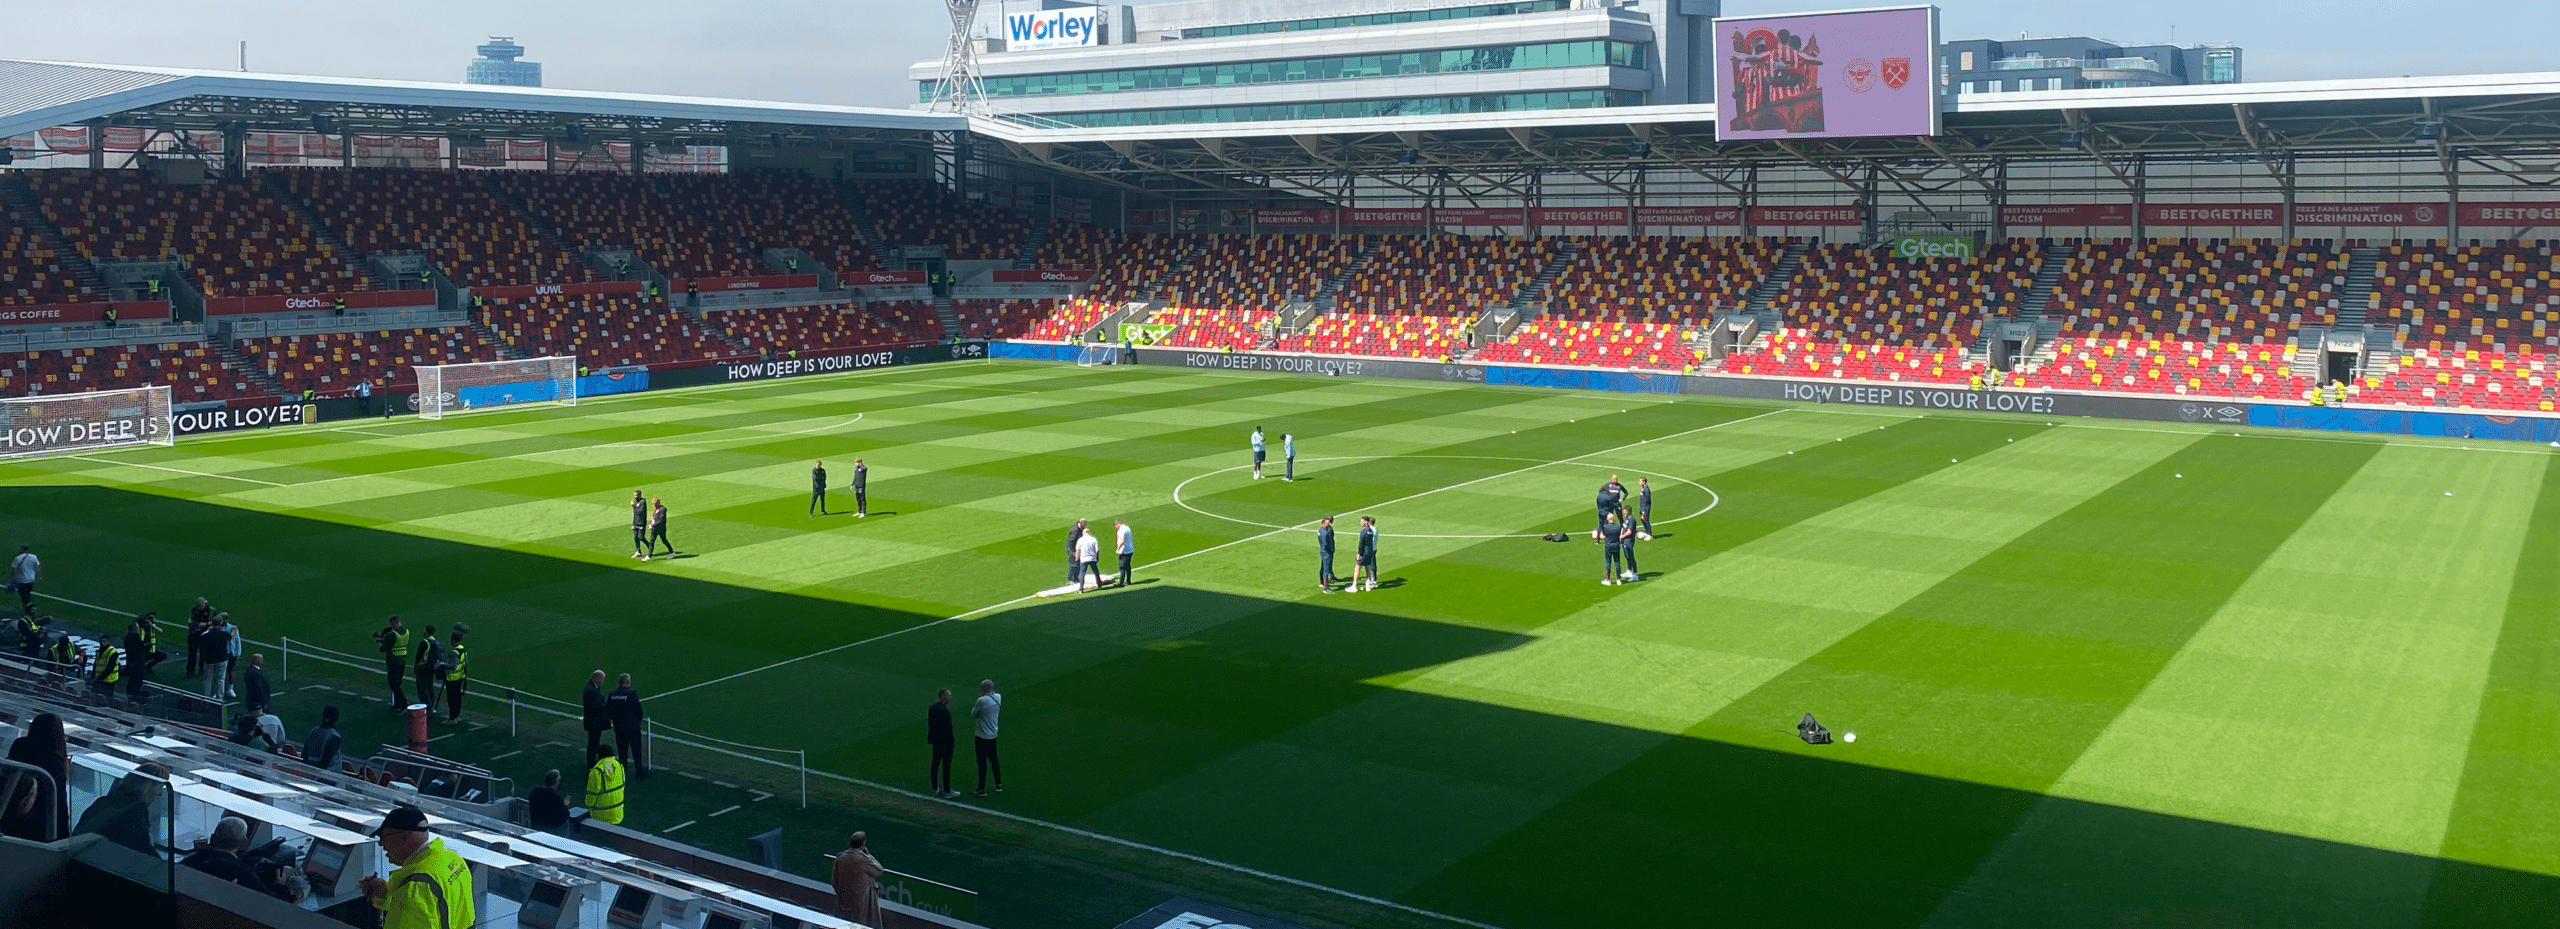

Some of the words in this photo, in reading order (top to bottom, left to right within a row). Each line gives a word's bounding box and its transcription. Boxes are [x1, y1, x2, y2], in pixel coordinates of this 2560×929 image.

[1009, 12, 1095, 45] Worley
[1354, 212, 1422, 221] BEETOGETHER
[1544, 211, 1623, 221] BEETOGETHER
[1637, 215, 1711, 223] DISCRIMINATION
[1764, 210, 1856, 220] BEETOGETHER
[2003, 215, 2043, 223] RACISM
[2160, 209, 2273, 220] BEETOGETHER
[2296, 214, 2403, 223] DISCRIMINATION
[1901, 238, 1968, 257] Gtech
[544, 285, 563, 295] UWL
[0, 310, 16, 320] GS
[20, 309, 60, 319] COFFEE
[728, 364, 763, 380] HOW
[767, 360, 800, 376] DEEP
[804, 358, 814, 373] IS
[818, 355, 852, 370] YOUR
[855, 352, 893, 367] LOVE?
[1186, 353, 1220, 367] HOW
[1223, 355, 1257, 370] DEEP
[1261, 357, 1272, 370] IS
[1276, 357, 1313, 372] YOUR
[1317, 360, 1362, 375] LOVE?
[1784, 383, 1834, 400] HOW
[1840, 387, 1892, 404] DEEP
[1898, 390, 1914, 406] IS
[1920, 391, 1979, 409] YOUR
[1986, 394, 2055, 413] LOVE?
[0, 425, 61, 448] HOW
[70, 419, 133, 442] DEEP
[141, 417, 158, 435] IS
[165, 411, 228, 432] YOUR
[234, 404, 301, 427] LOVE?
